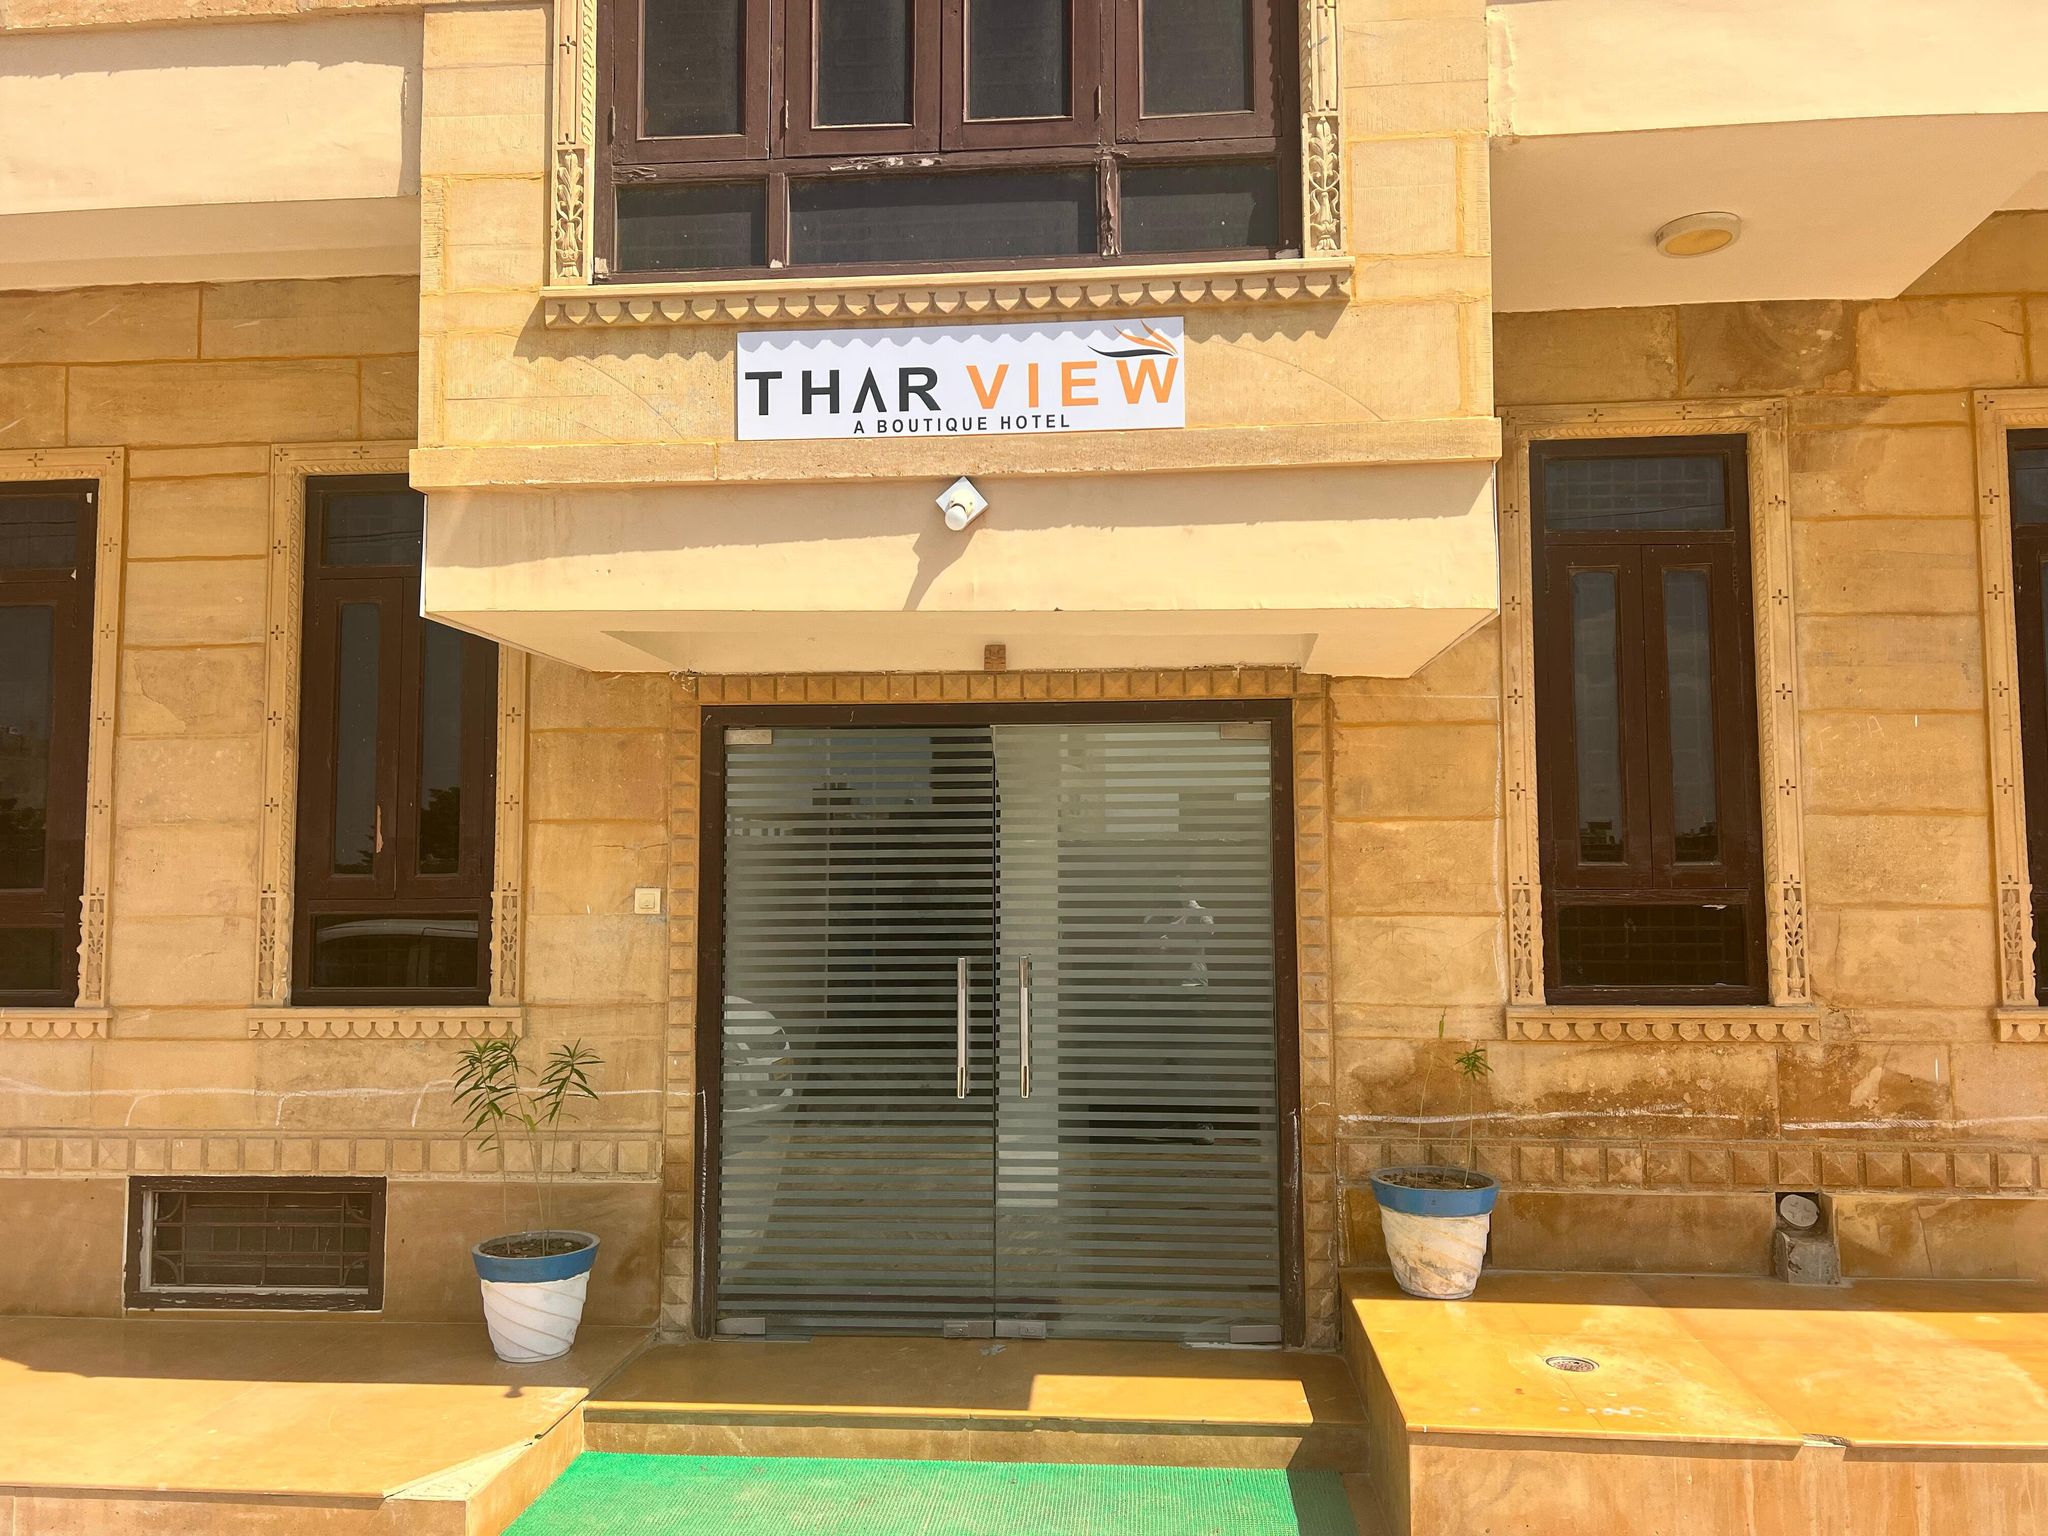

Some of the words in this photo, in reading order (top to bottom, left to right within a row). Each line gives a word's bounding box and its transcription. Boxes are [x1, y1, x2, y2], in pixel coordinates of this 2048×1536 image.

[744, 366, 942, 416] THAR
[966, 357, 1178, 409] VIEW
[853, 420, 865, 434] A
[877, 416, 987, 434] BOUTIQUE
[1000, 414, 1070, 430] HOTEL
